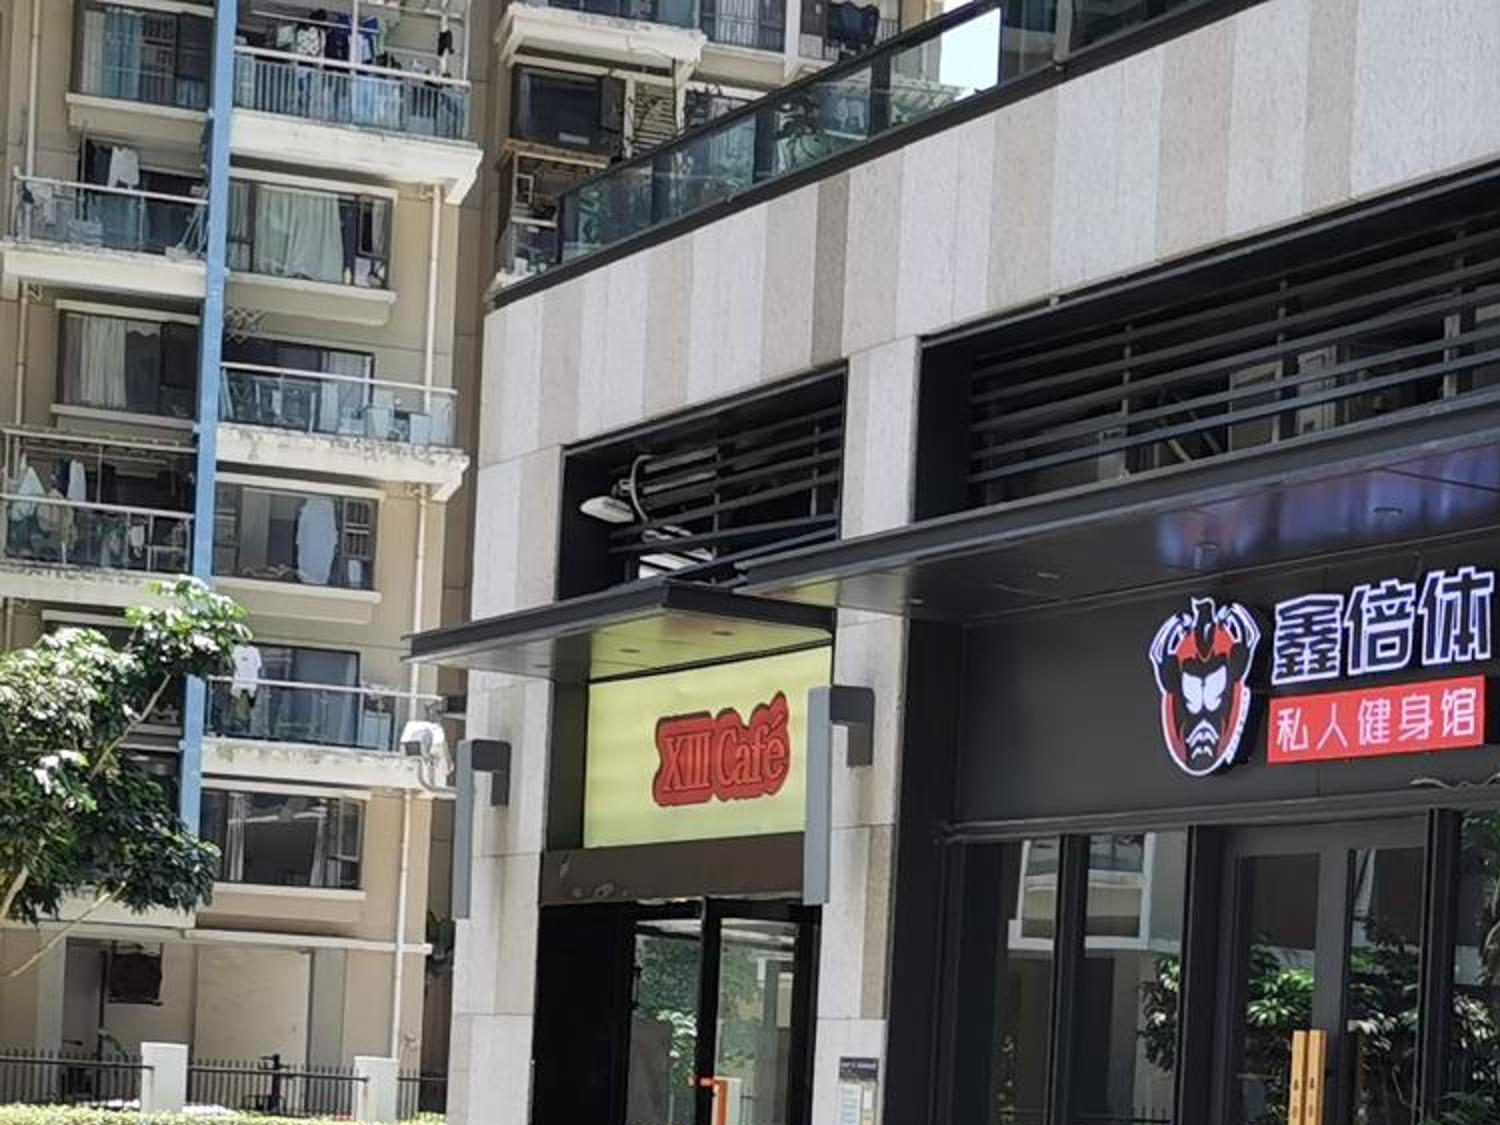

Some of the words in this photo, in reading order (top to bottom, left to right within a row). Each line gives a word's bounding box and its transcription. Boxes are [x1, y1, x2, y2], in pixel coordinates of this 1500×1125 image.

[1272, 566, 1494, 685] 鑫倍体
[662, 731, 713, 792] XIII
[716, 716, 786, 788] Café
[1277, 687, 1478, 754] 私人健身馆
